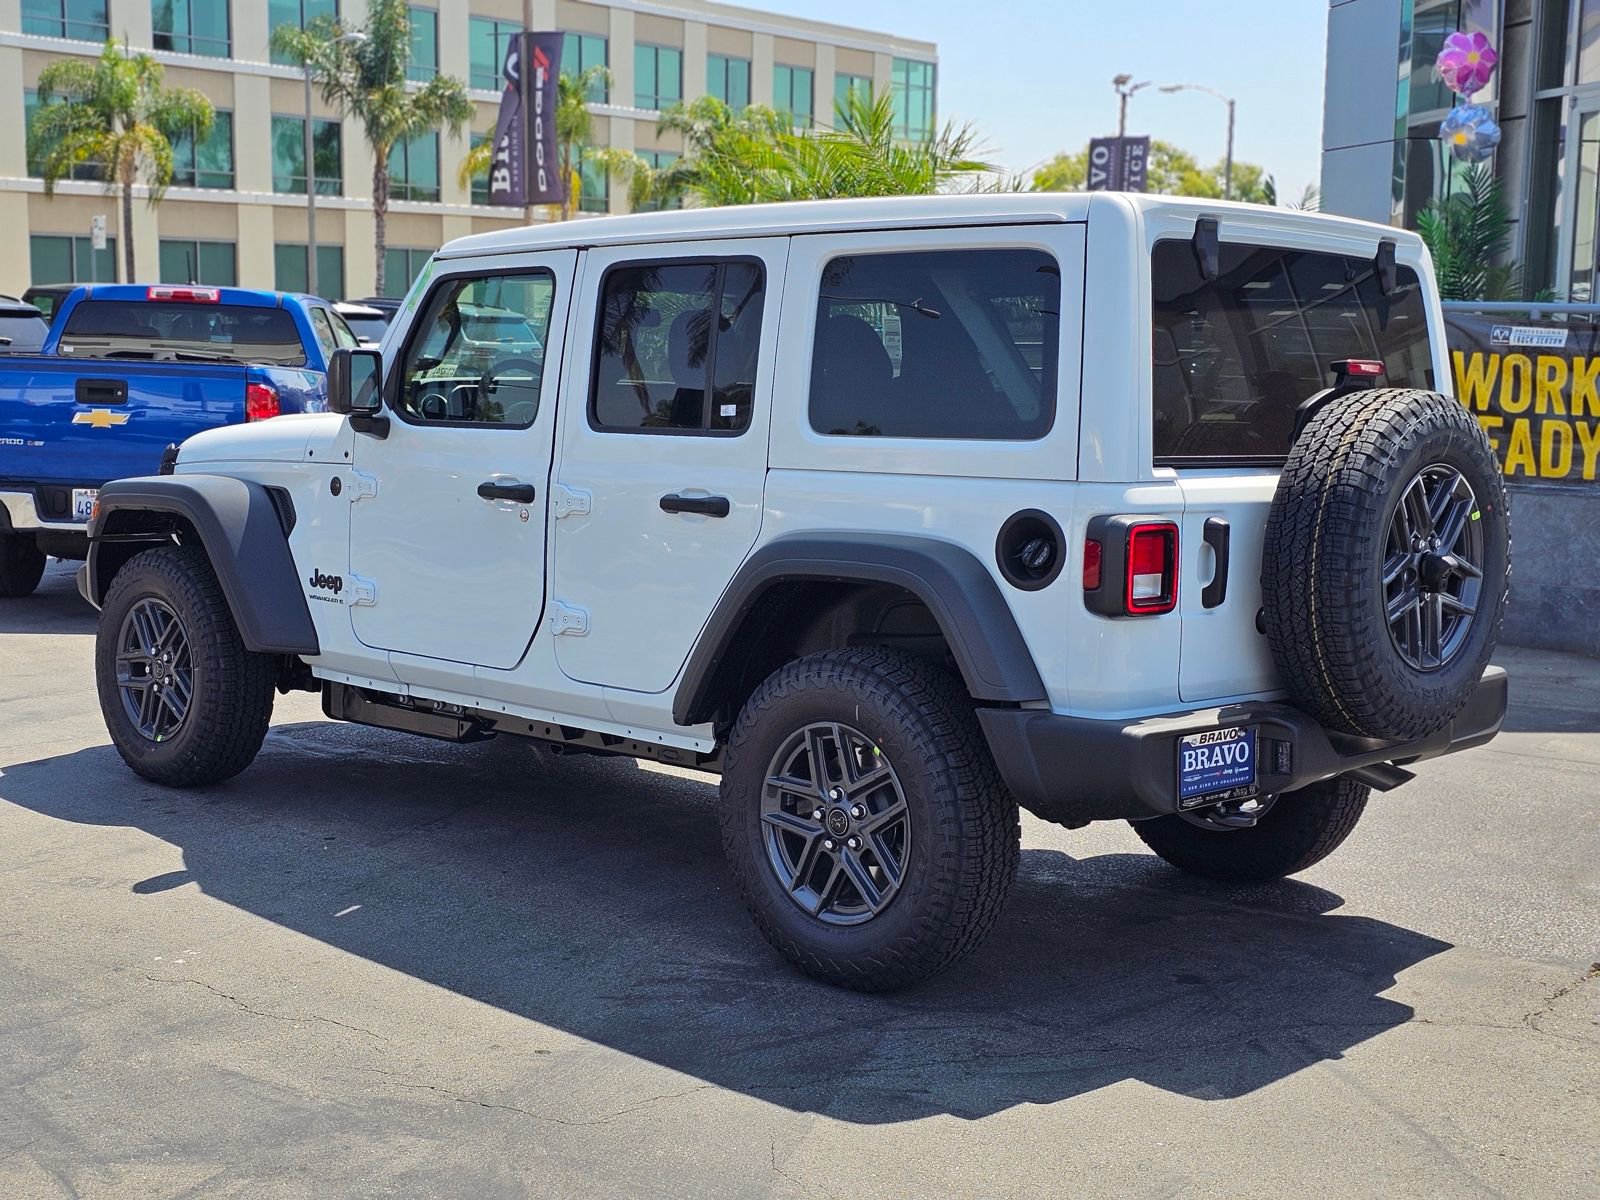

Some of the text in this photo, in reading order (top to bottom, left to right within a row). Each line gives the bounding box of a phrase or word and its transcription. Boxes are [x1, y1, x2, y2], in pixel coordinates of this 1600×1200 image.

[535, 67, 547, 192] DODGE
[1452, 351, 1600, 416] WORK
[1478, 416, 1600, 481] EADY
[309, 568, 342, 594] Jeep
[1183, 741, 1249, 772] BRAVO
[1199, 729, 1237, 744] BRAVO
